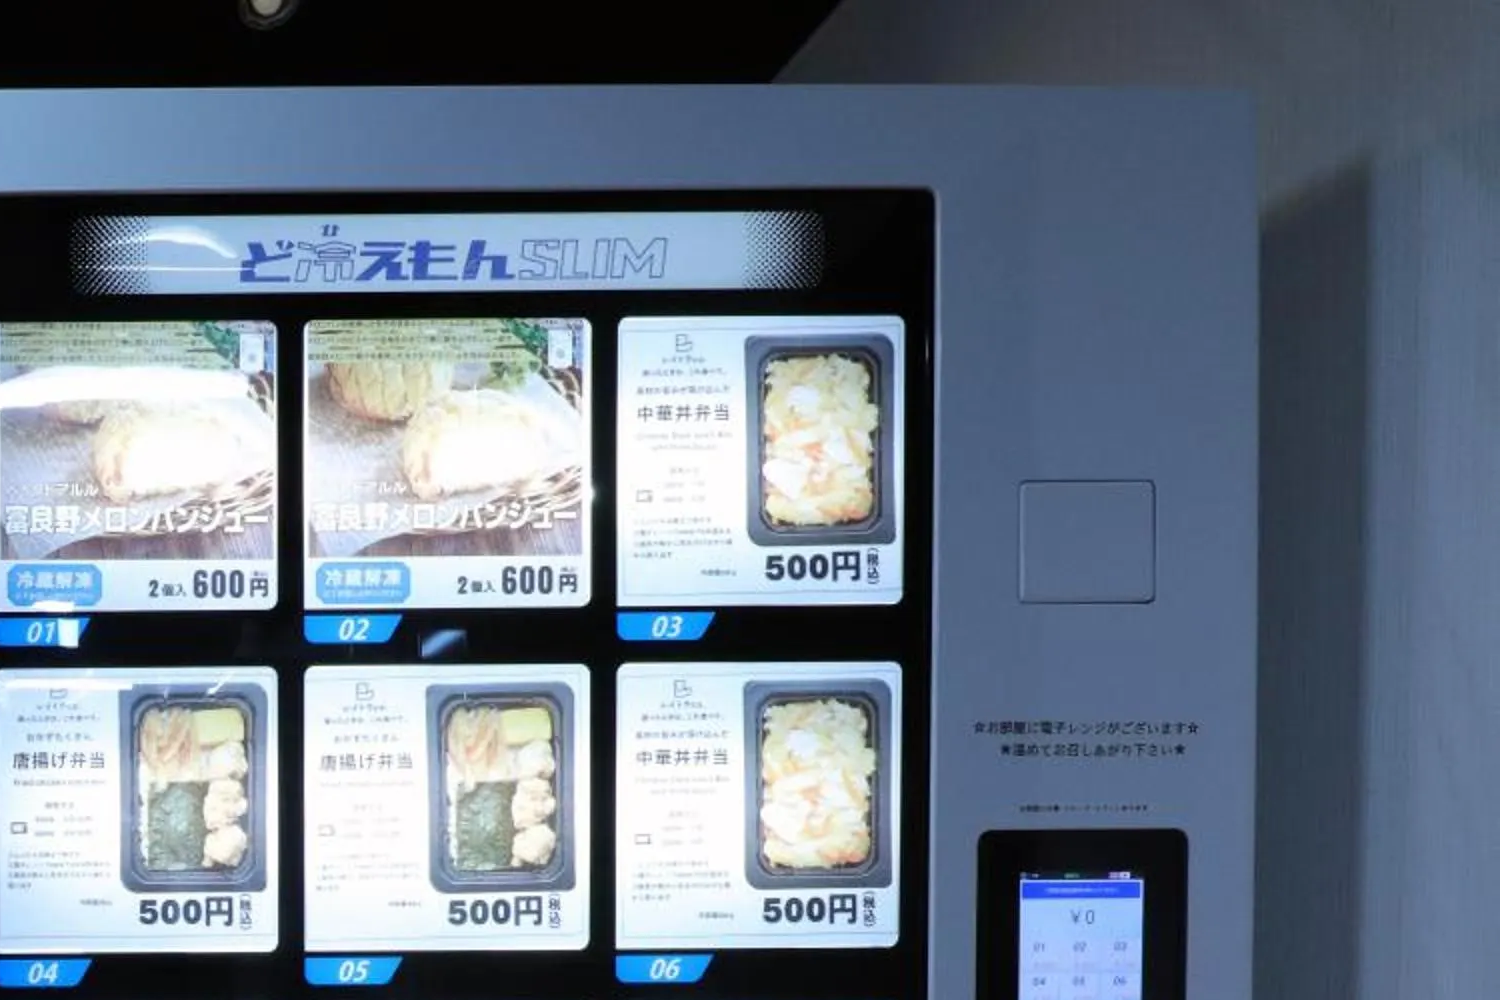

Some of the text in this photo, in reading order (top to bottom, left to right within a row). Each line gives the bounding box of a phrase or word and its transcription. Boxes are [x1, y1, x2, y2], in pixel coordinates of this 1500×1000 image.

[240, 237, 669, 283] ど冷えもん SLIM
[502, 566, 577, 595] 600円
[764, 551, 861, 582] 500円
[193, 569, 269, 598] 600円
[338, 617, 371, 641] 02
[651, 615, 683, 638] 03
[138, 896, 234, 927] 500円
[447, 895, 542, 927] 500円
[762, 894, 857, 924] 500円
[28, 962, 59, 985] 04
[338, 960, 370, 983] 05
[649, 958, 681, 981] 06
